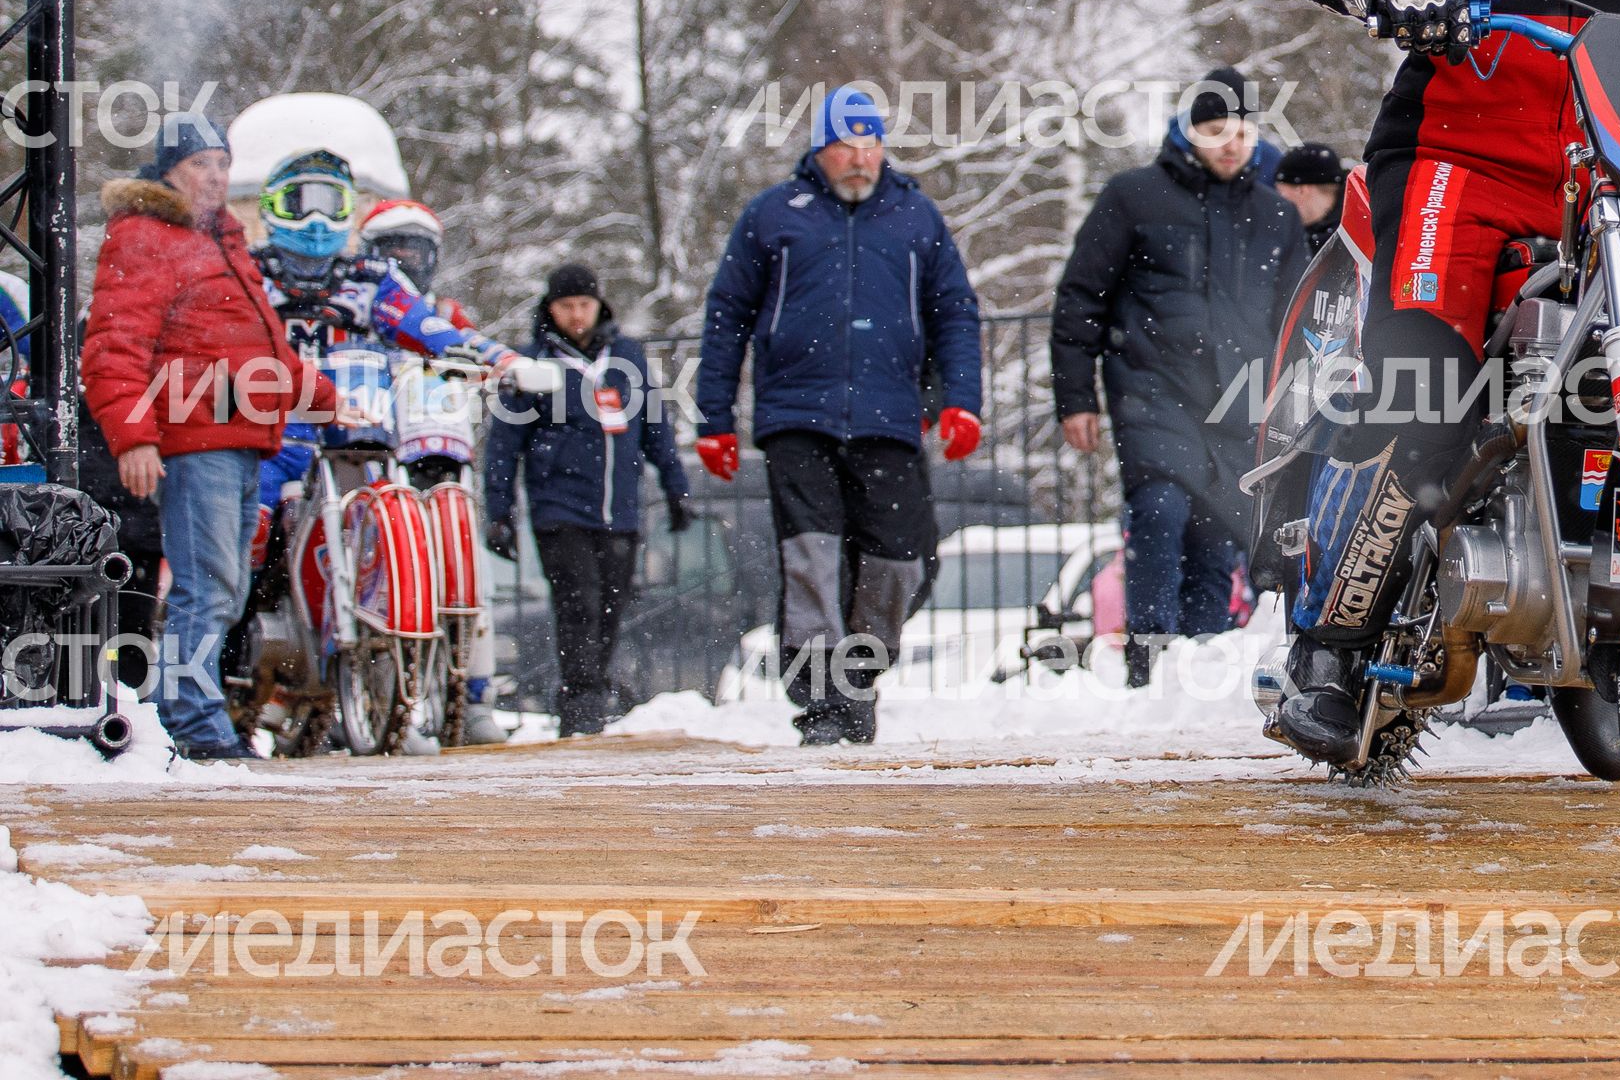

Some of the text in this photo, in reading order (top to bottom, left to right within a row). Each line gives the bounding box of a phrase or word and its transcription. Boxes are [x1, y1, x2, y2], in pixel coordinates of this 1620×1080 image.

[1410, 161, 1454, 271] Каменск-Уральский
[1333, 481, 1416, 627] KOLTAKOV
[1340, 520, 1371, 580] DMITRY
